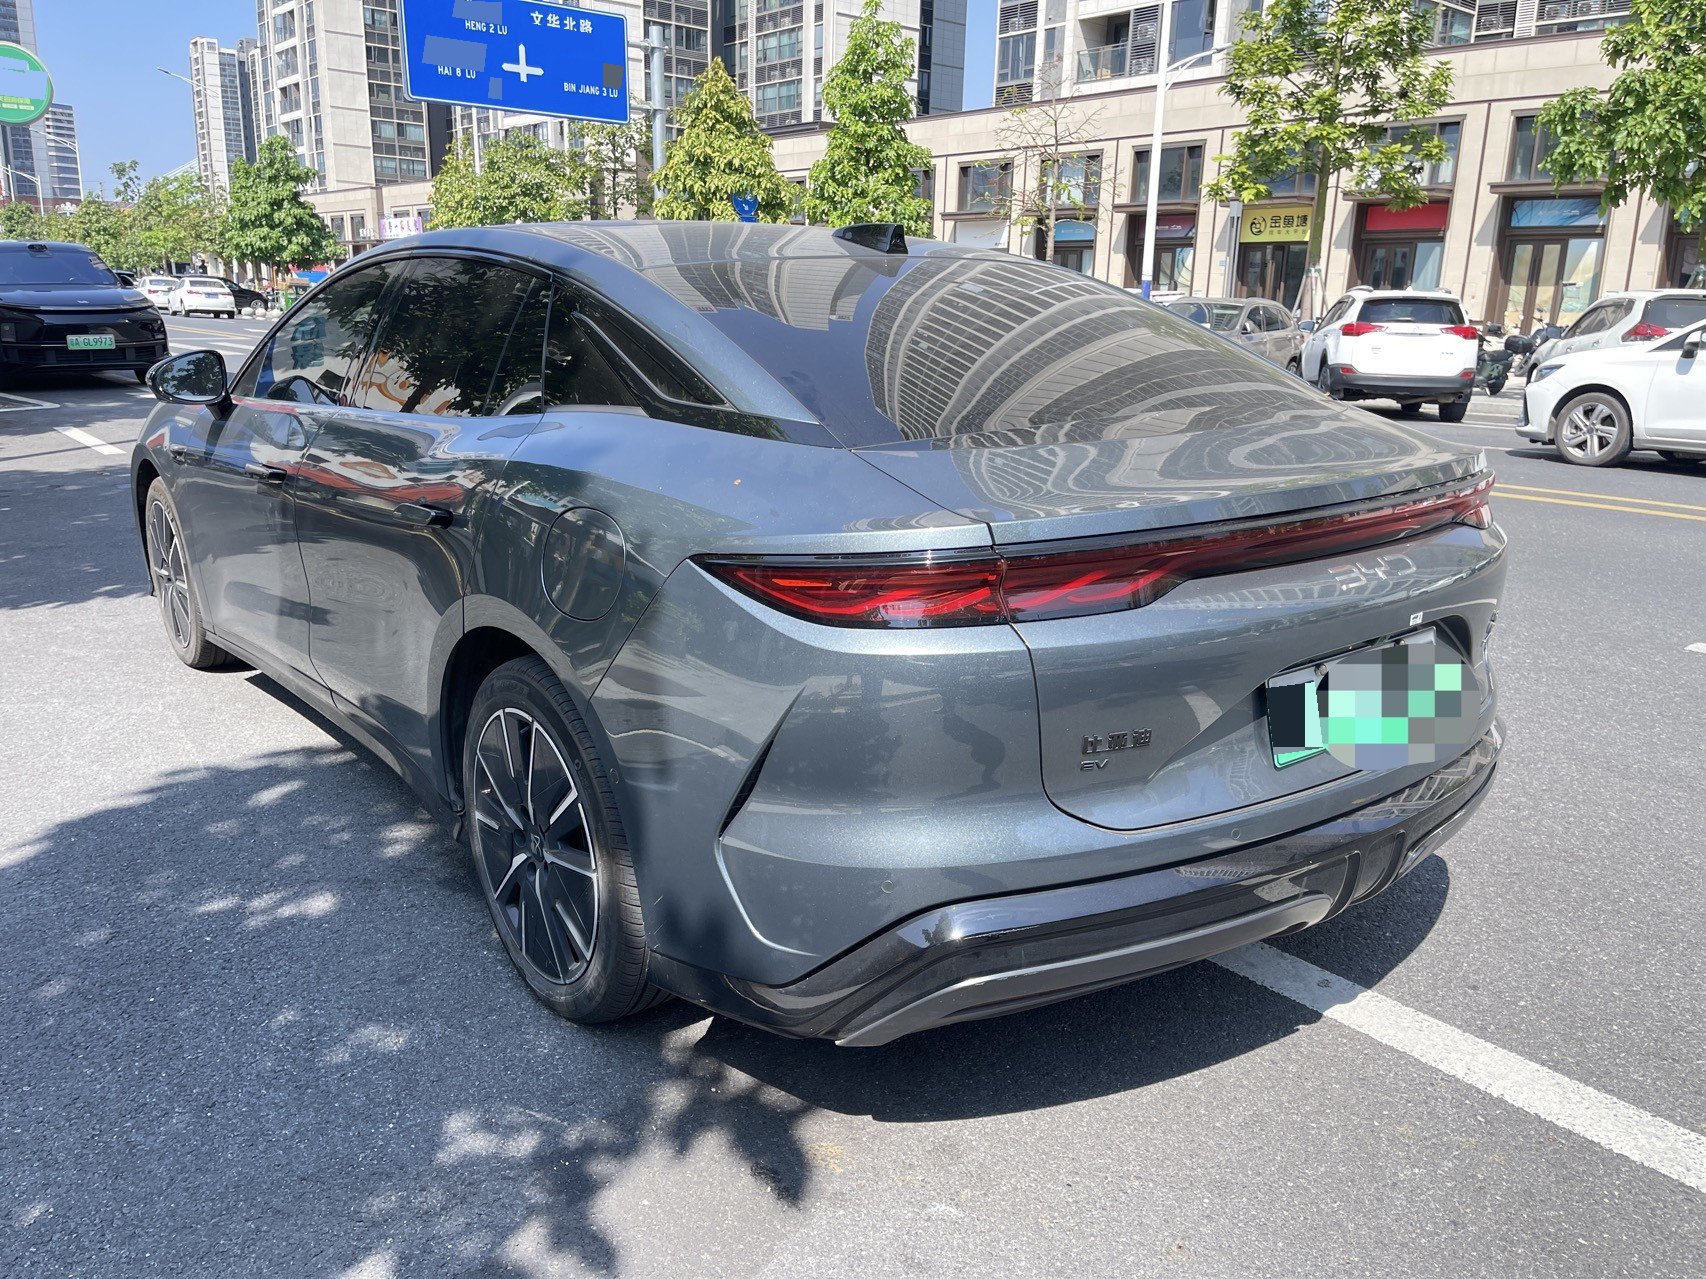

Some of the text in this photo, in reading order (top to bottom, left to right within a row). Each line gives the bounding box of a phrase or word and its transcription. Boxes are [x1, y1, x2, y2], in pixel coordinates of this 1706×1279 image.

[465, 20, 508, 35] HENG 2 LU
[530, 10, 593, 34] 文华北路
[438, 65, 476, 79] HAI 8 LU
[563, 82, 618, 98] BIN JIANG 3 LU
[1269, 214, 1309, 229] 金鱼塘
[1328, 553, 1417, 592] BYD
[1081, 727, 1152, 754] 比亚迪
[1080, 758, 1109, 771] EV
